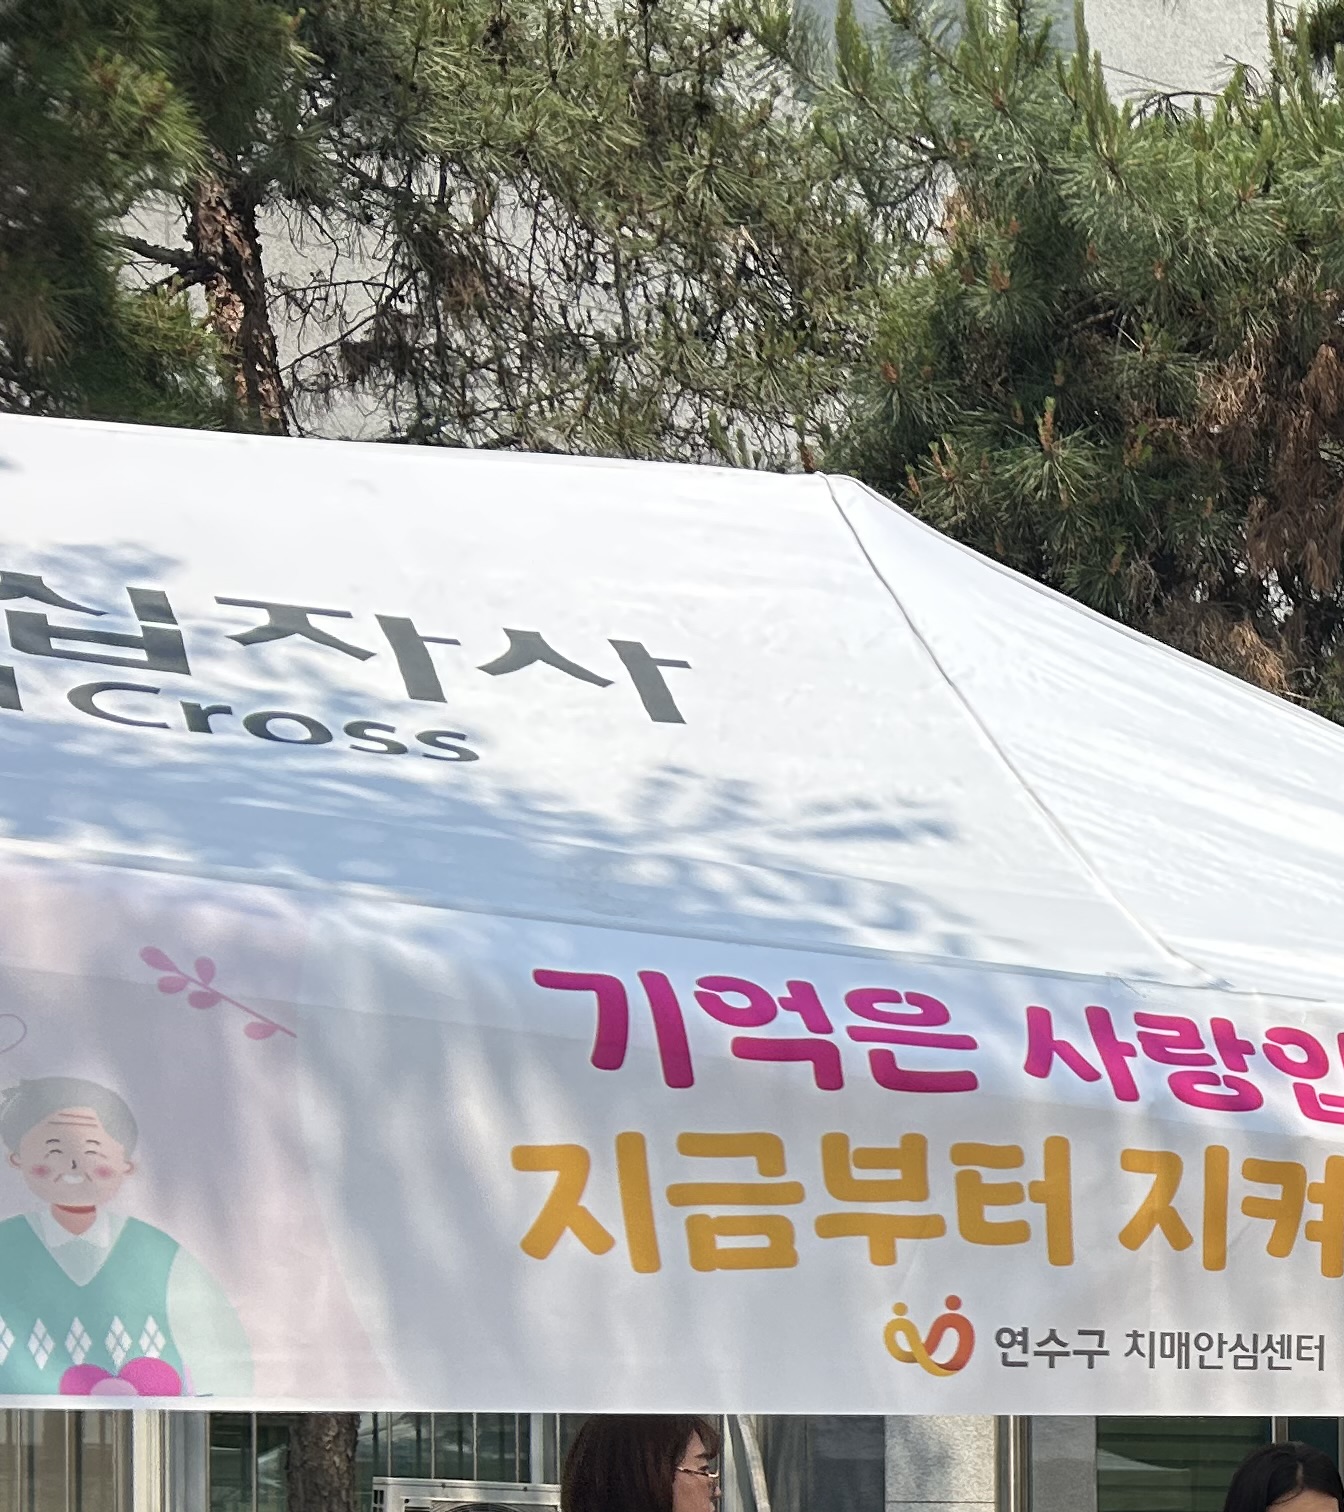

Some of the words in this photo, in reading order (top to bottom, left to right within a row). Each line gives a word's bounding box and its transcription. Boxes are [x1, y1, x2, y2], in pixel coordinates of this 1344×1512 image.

[67, 680, 480, 763] Cross
[532, 968, 979, 1092] 기억은
[511, 1131, 1073, 1274] 지금부터
[995, 1325, 1109, 1369] 연수구
[1123, 1330, 1326, 1372] 치매안심센터
